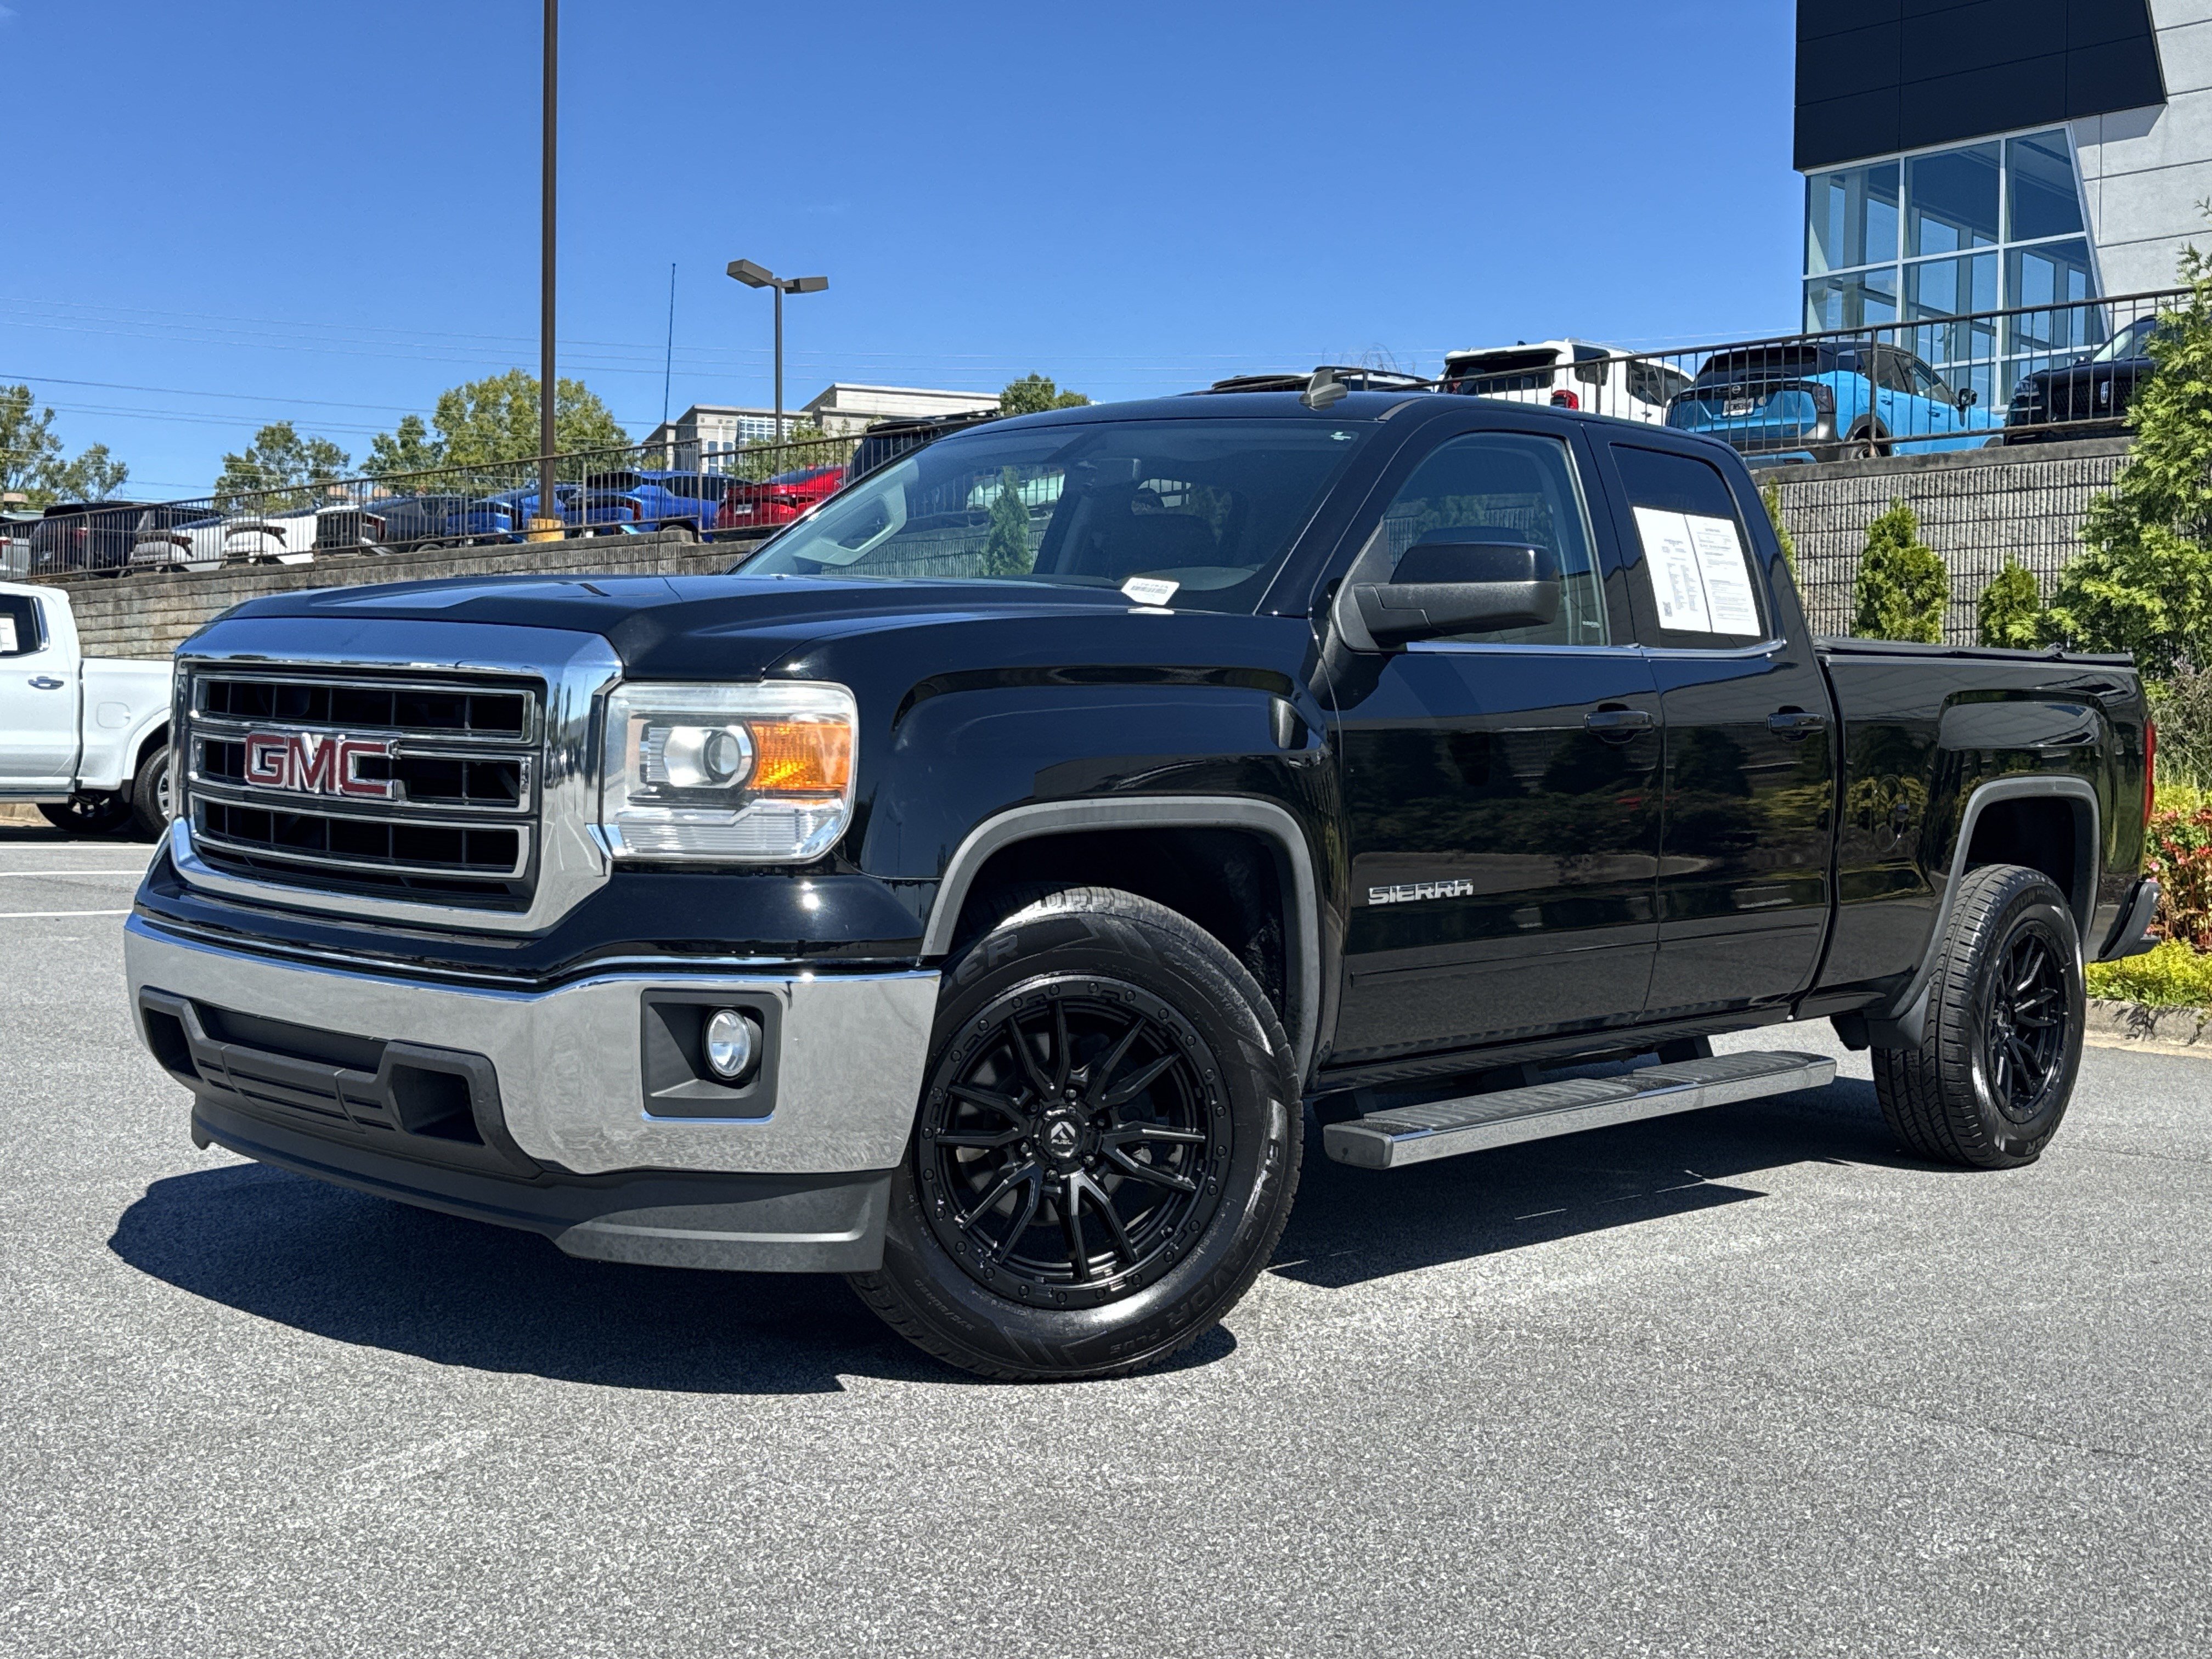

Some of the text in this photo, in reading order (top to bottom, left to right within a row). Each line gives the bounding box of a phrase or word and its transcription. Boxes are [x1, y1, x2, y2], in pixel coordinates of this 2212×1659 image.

[245, 731, 393, 800] GMC
[1368, 879, 1474, 905] SIERRA
[1109, 1328, 1161, 1356] PLUS
